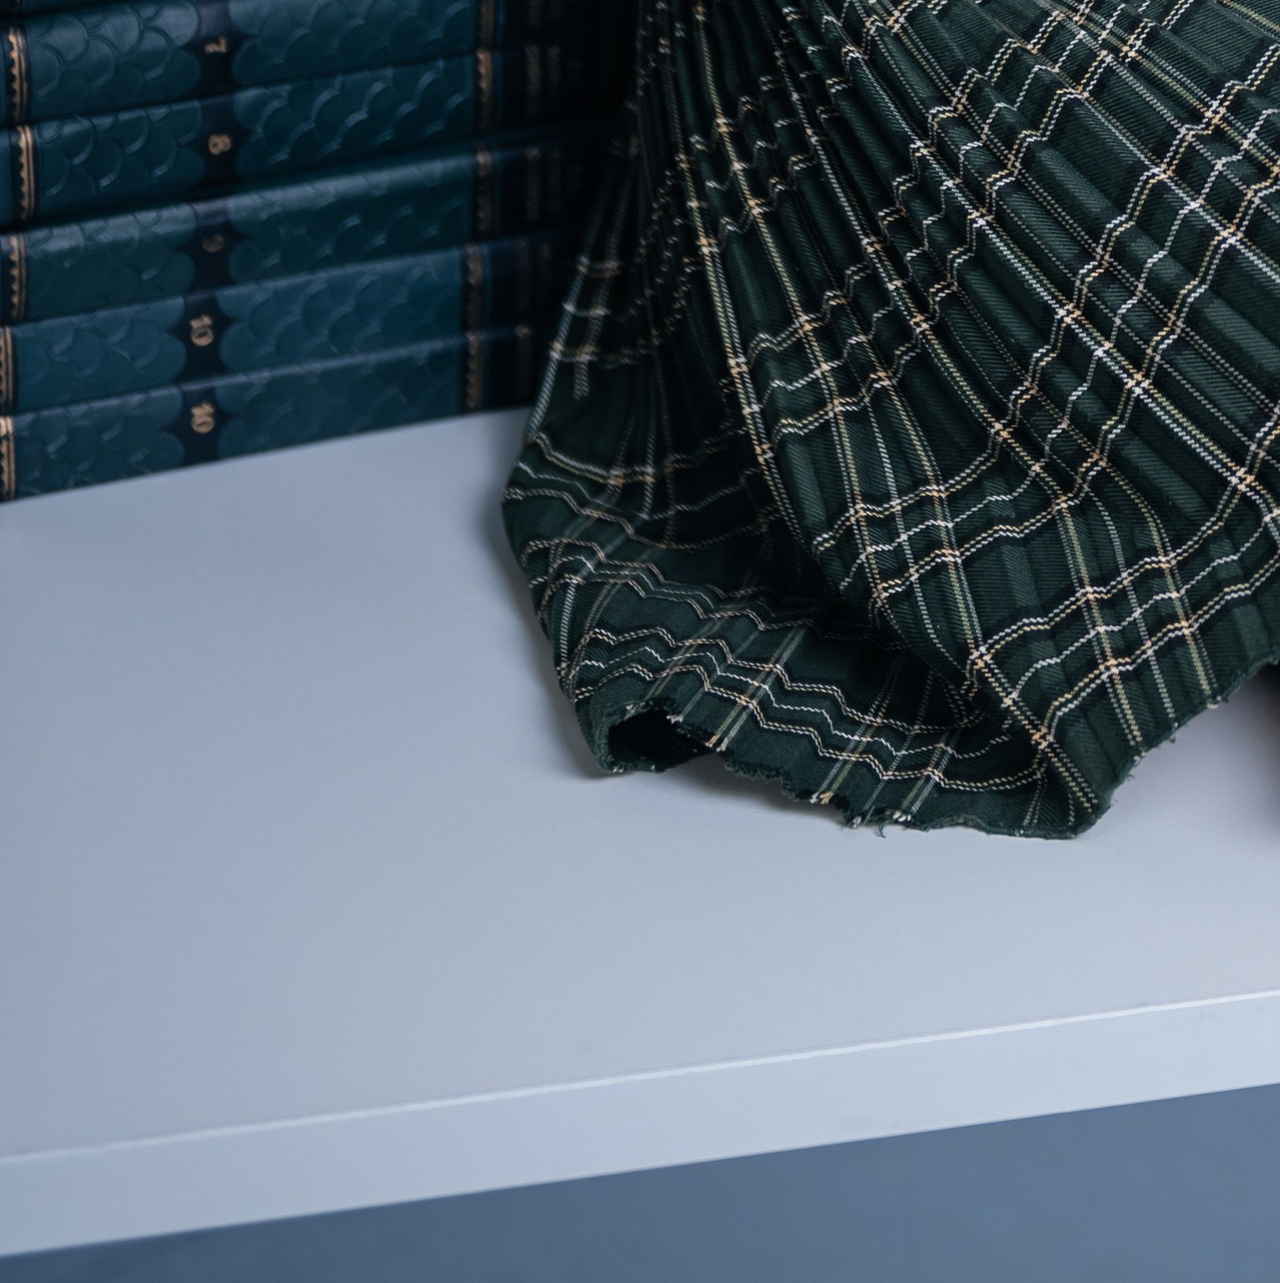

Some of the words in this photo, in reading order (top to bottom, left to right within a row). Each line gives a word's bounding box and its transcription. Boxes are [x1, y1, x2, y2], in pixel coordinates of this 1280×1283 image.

[204, 35, 227, 53] 7
[208, 134, 231, 155] 8
[190, 315, 214, 346] 10
